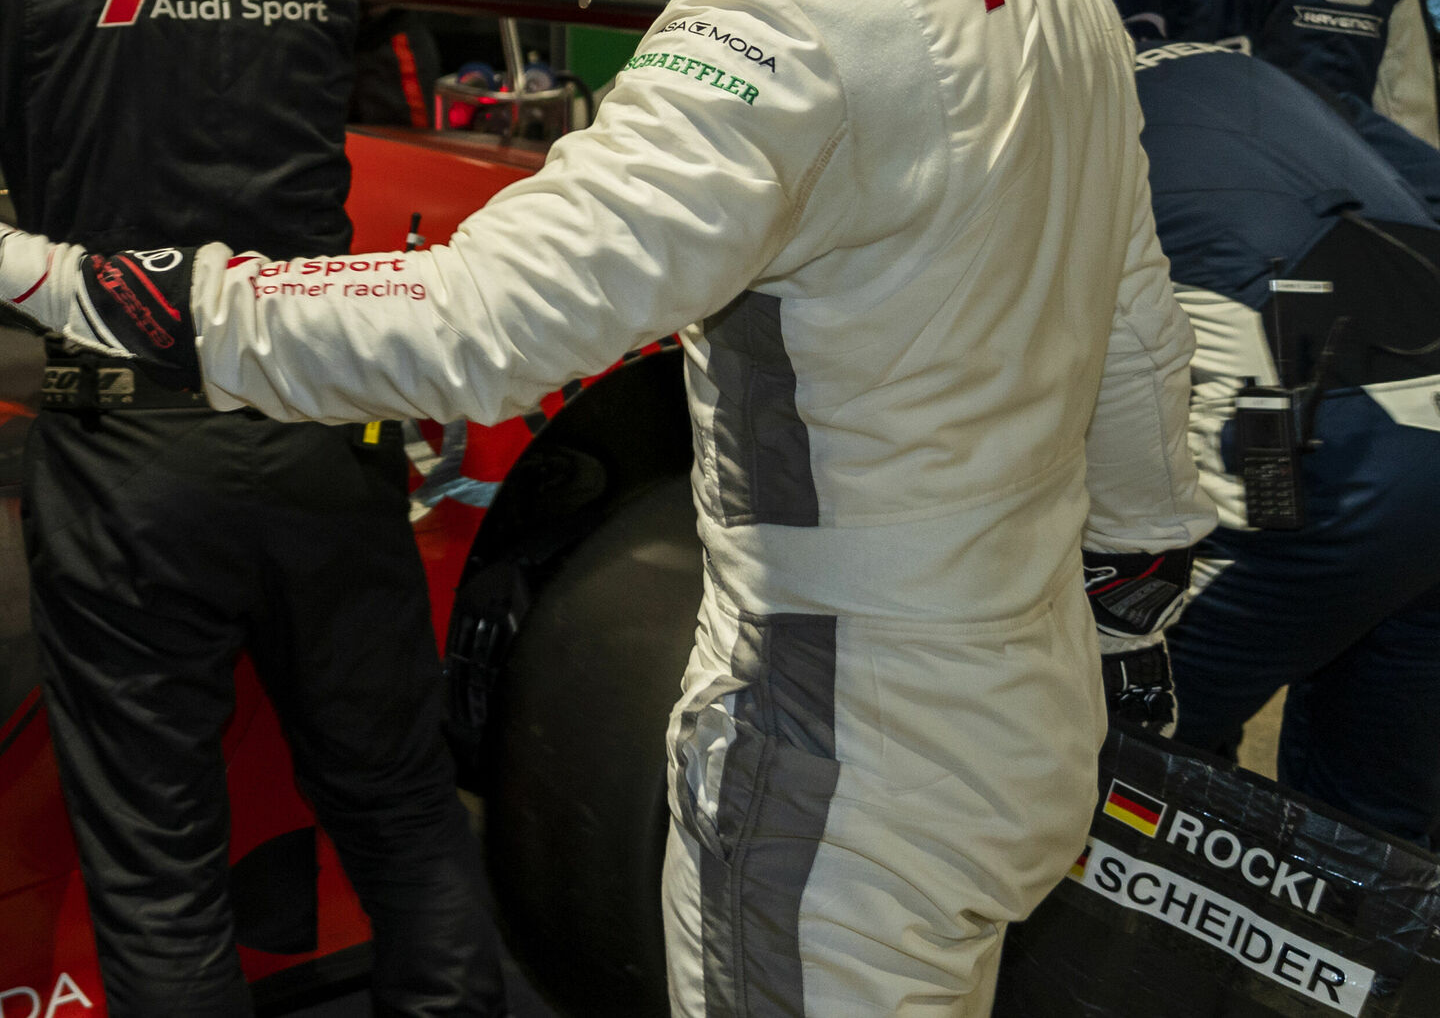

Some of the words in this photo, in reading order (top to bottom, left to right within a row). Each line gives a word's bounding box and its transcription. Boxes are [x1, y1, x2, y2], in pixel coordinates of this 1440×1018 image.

[708, 26, 777, 74] MODA
[624, 52, 760, 106] SCHAEFFLER
[301, 257, 405, 276] sport
[343, 280, 426, 301] racing
[1166, 810, 1329, 915] ROCKI
[1094, 856, 1346, 1004] SCHEIDER
